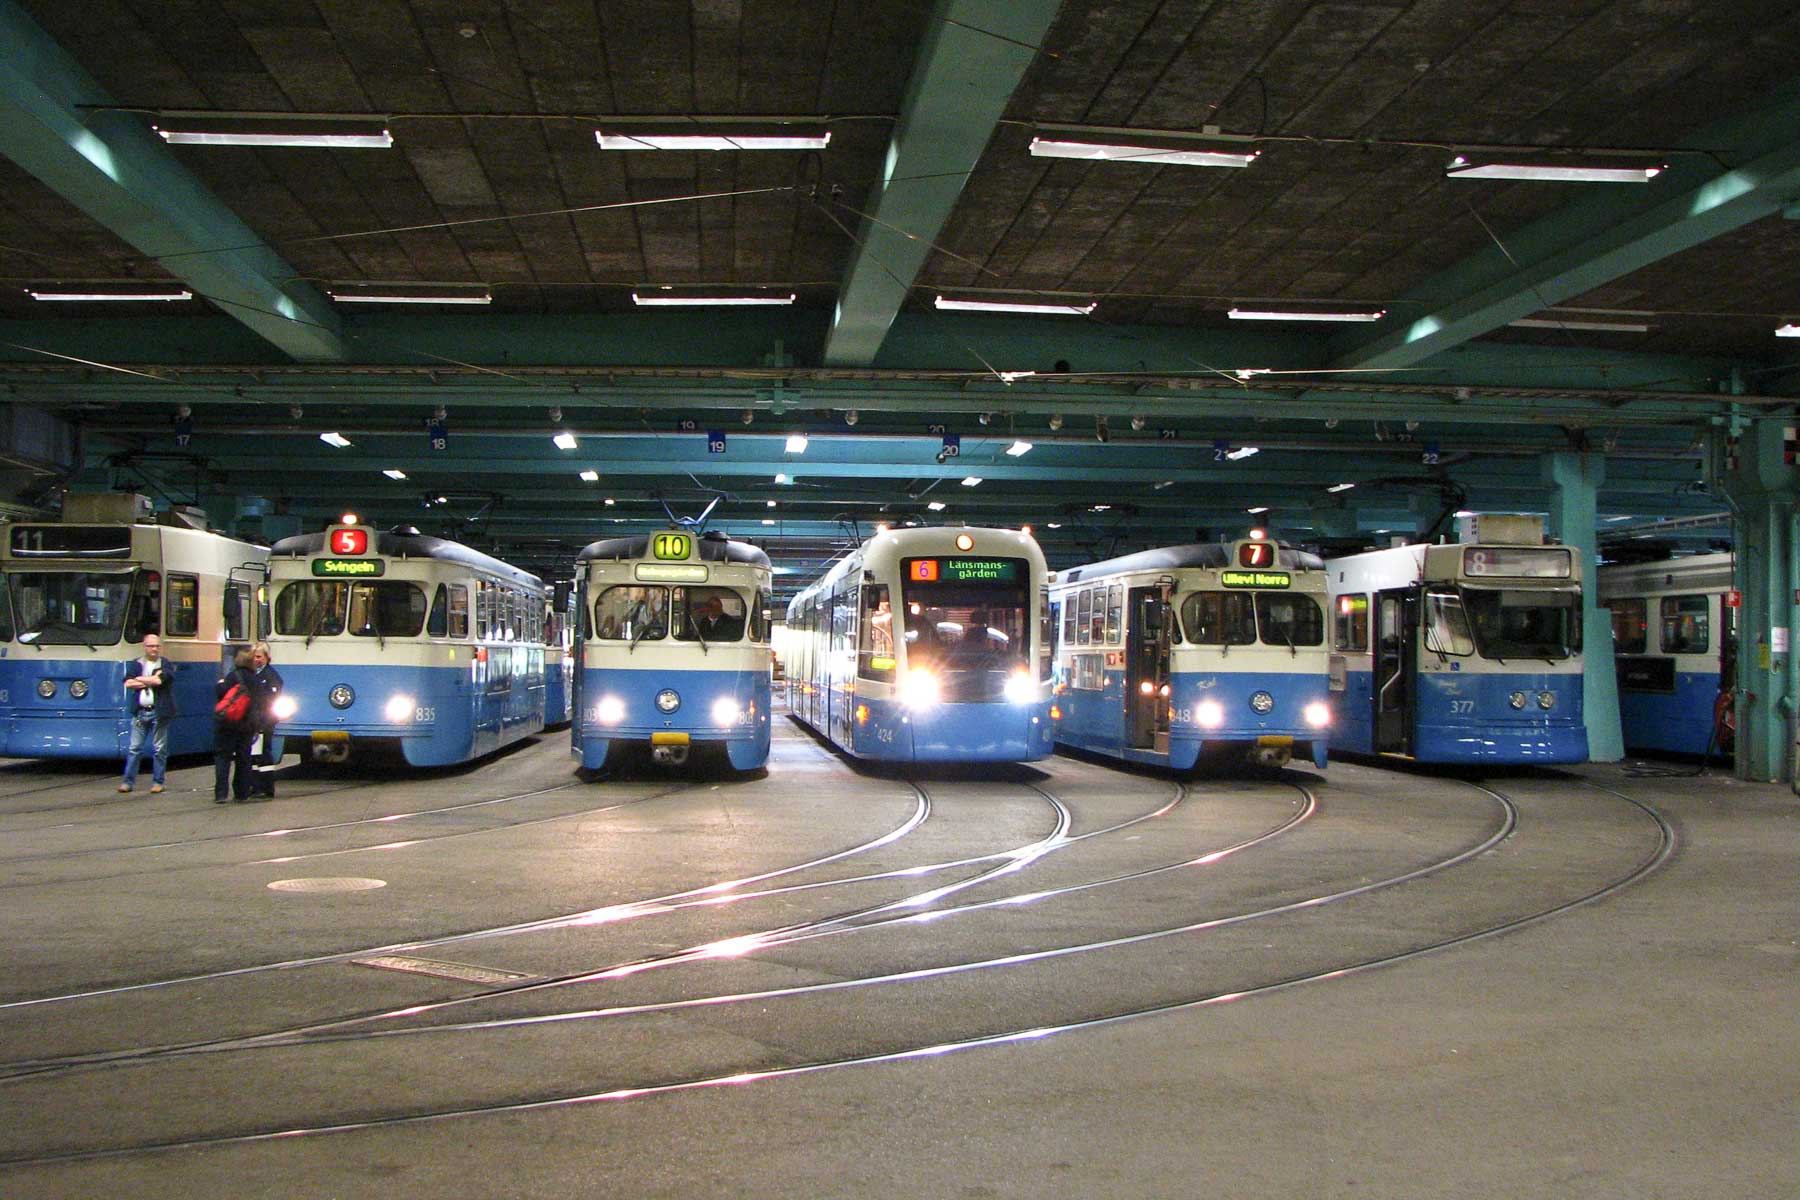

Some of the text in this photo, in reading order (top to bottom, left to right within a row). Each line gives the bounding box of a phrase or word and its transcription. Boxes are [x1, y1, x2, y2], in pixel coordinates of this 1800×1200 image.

[177, 434, 190, 446] 17
[432, 438, 446, 450] 18
[710, 441, 725, 452] 19
[943, 445, 959, 456] 20
[1422, 453, 1440, 464] 22
[18, 531, 43, 550] 11
[342, 532, 355, 552] 5
[660, 536, 684, 556] 10
[1249, 545, 1262, 564] 7
[949, 560, 1007, 569] Länsmans-
[1473, 551, 1486, 573] 8
[919, 562, 929, 578] 6
[959, 569, 997, 580] gården
[1222, 573, 1289, 585] Ullevi Norra
[1450, 700, 1474, 713] 377
[416, 707, 436, 720] 835
[877, 728, 893, 743] 424
